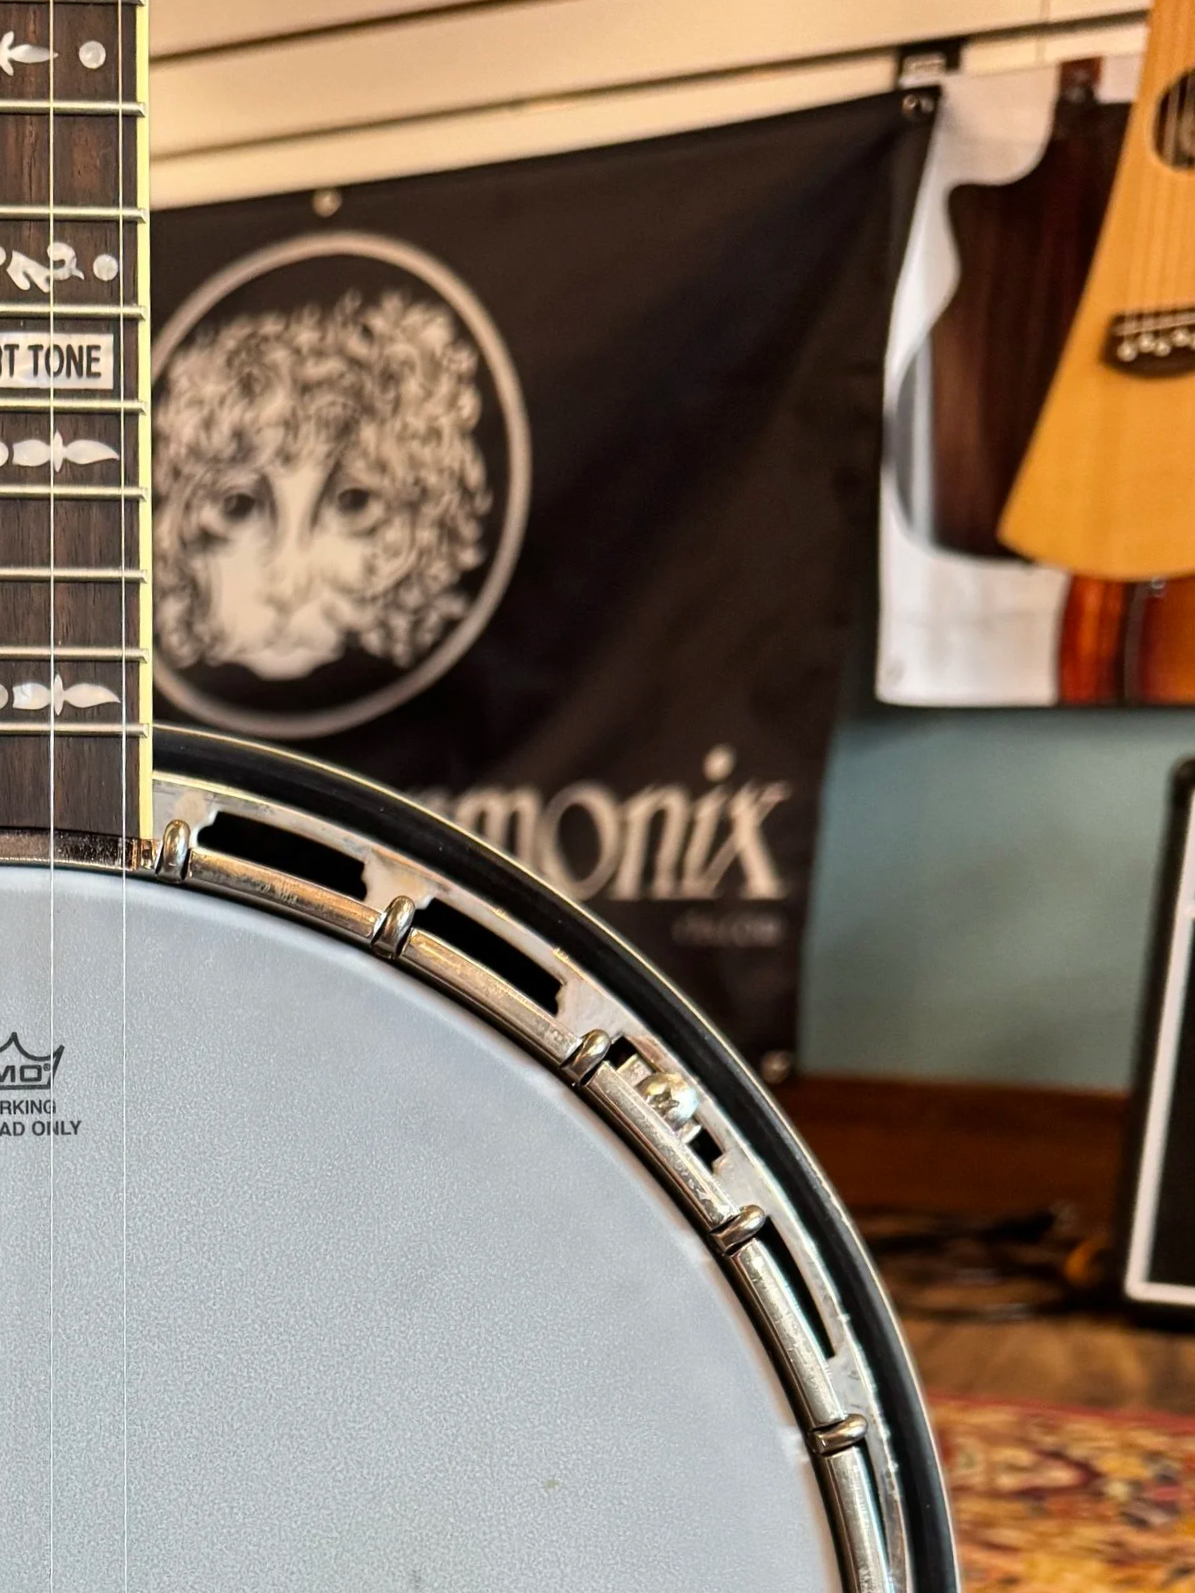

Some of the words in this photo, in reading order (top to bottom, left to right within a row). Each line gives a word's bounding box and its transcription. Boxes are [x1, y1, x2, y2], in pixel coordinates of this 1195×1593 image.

[27, 343, 102, 379] TONE
[413, 743, 791, 902] monix
[31, 1120, 82, 1136] ONLY
